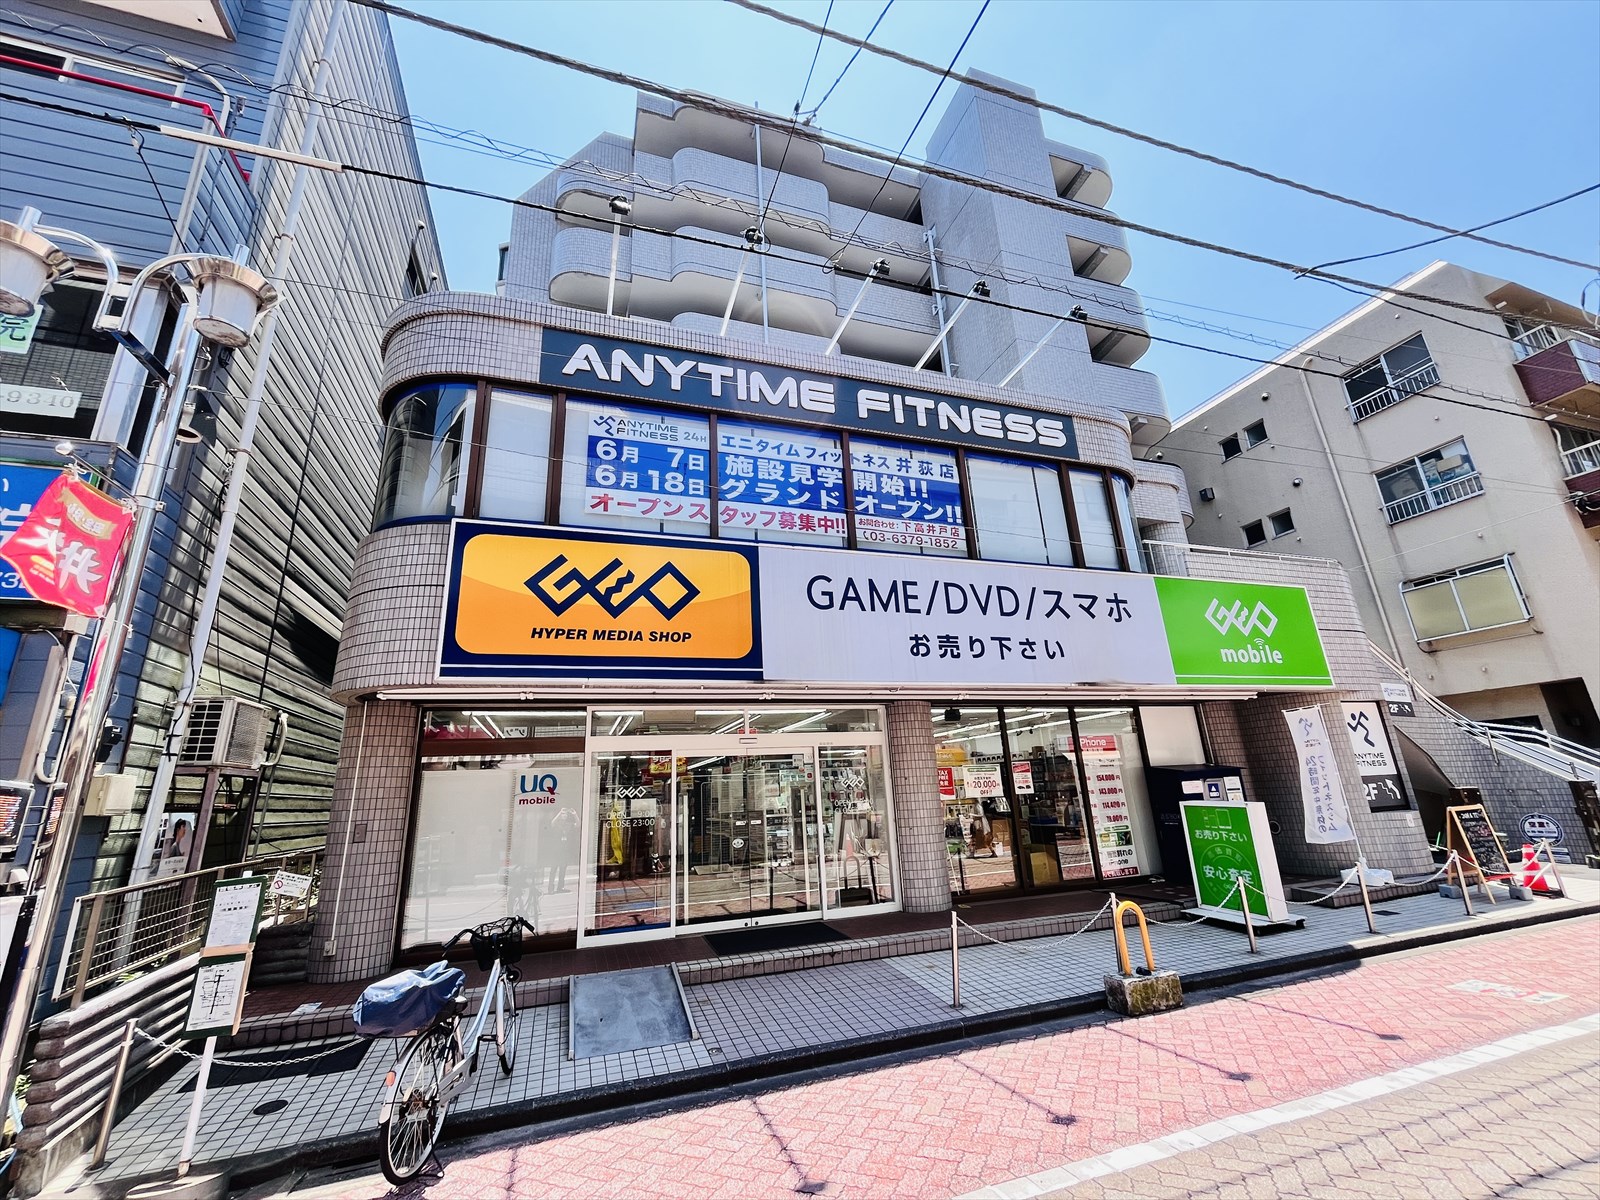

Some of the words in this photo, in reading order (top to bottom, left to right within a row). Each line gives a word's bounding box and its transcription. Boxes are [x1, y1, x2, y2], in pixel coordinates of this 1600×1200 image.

[561, 343, 836, 415] ANYTIME
[856, 388, 1067, 448] FITNESS
[617, 419, 678, 433] ANYTIME
[616, 427, 679, 441] FITNESS
[683, 431, 707, 443] 24H
[869, 531, 958, 549] 03-6379-1852
[523, 553, 701, 621] GEO
[806, 574, 1133, 623] GAME/DVD/スマホ
[1204, 597, 1279, 638] GEO
[530, 627, 588, 640] HYPER
[592, 629, 644, 642] MEDIA
[648, 630, 692, 643] SHOP
[908, 634, 1066, 661] お売り下さい
[1220, 644, 1283, 664] mobile
[1389, 703, 1399, 713] 2F
[520, 773, 558, 795] UQ
[617, 786, 647, 798] GEO
[518, 796, 556, 805] mobile
[606, 811, 628, 819] OPEN
[606, 819, 631, 828] CLOSE
[632, 818, 656, 827] 23:00
[1194, 829, 1248, 842] お売り下さい
[1203, 865, 1254, 885] 安心査定
